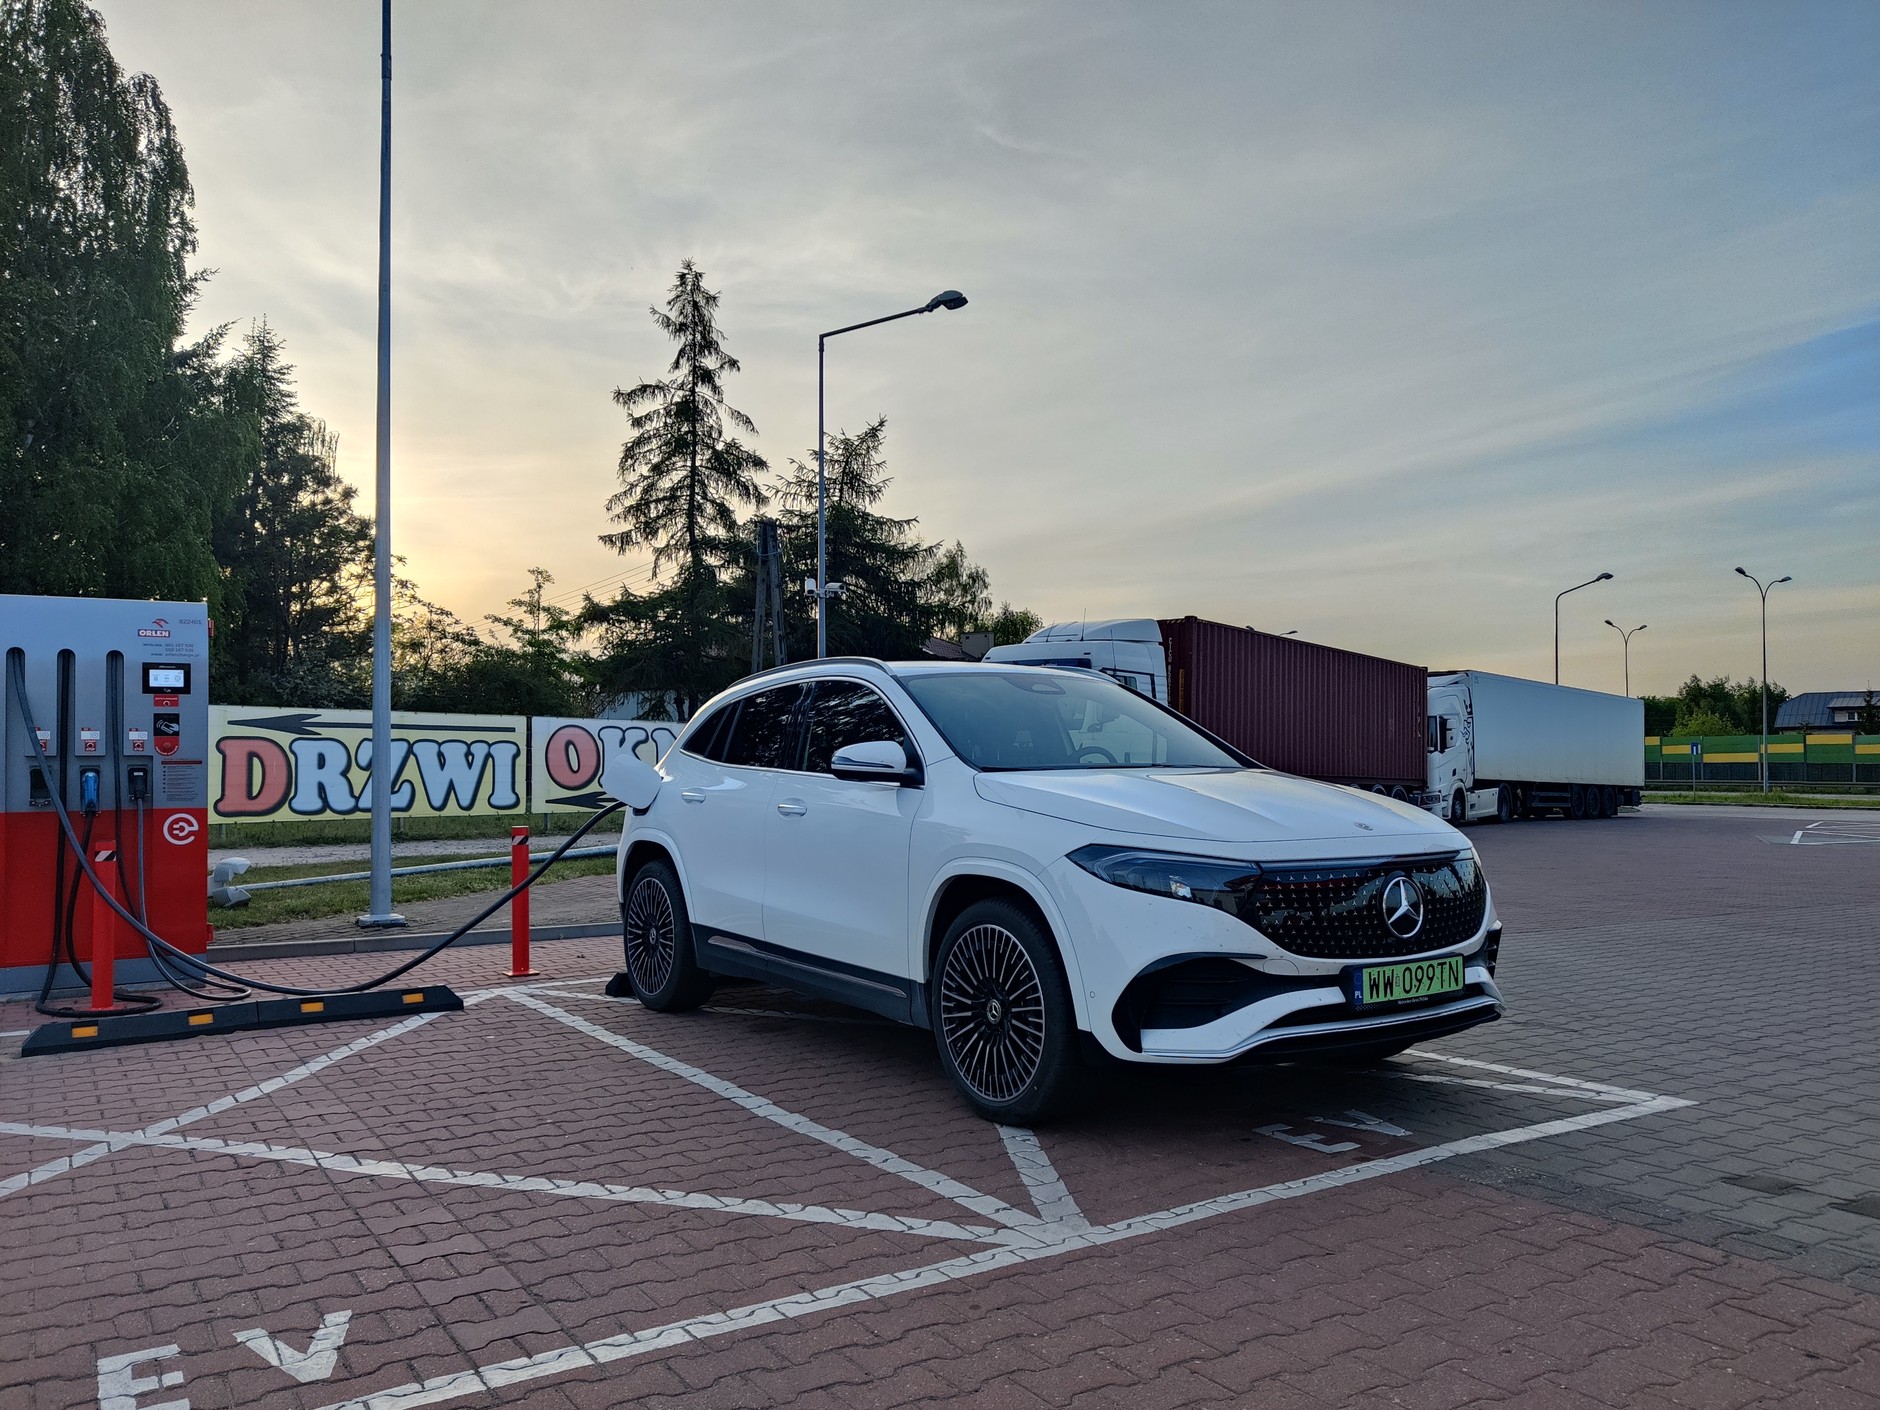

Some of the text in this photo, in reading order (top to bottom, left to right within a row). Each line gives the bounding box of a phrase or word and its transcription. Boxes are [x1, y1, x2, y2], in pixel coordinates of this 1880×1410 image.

[213, 736, 521, 817] DRZWI
[544, 724, 677, 792] OK
[1354, 990, 1363, 999] PL
[1368, 960, 1459, 999] WW 099TN
[1251, 1109, 1413, 1154] EV
[97, 1309, 353, 1410] EV
